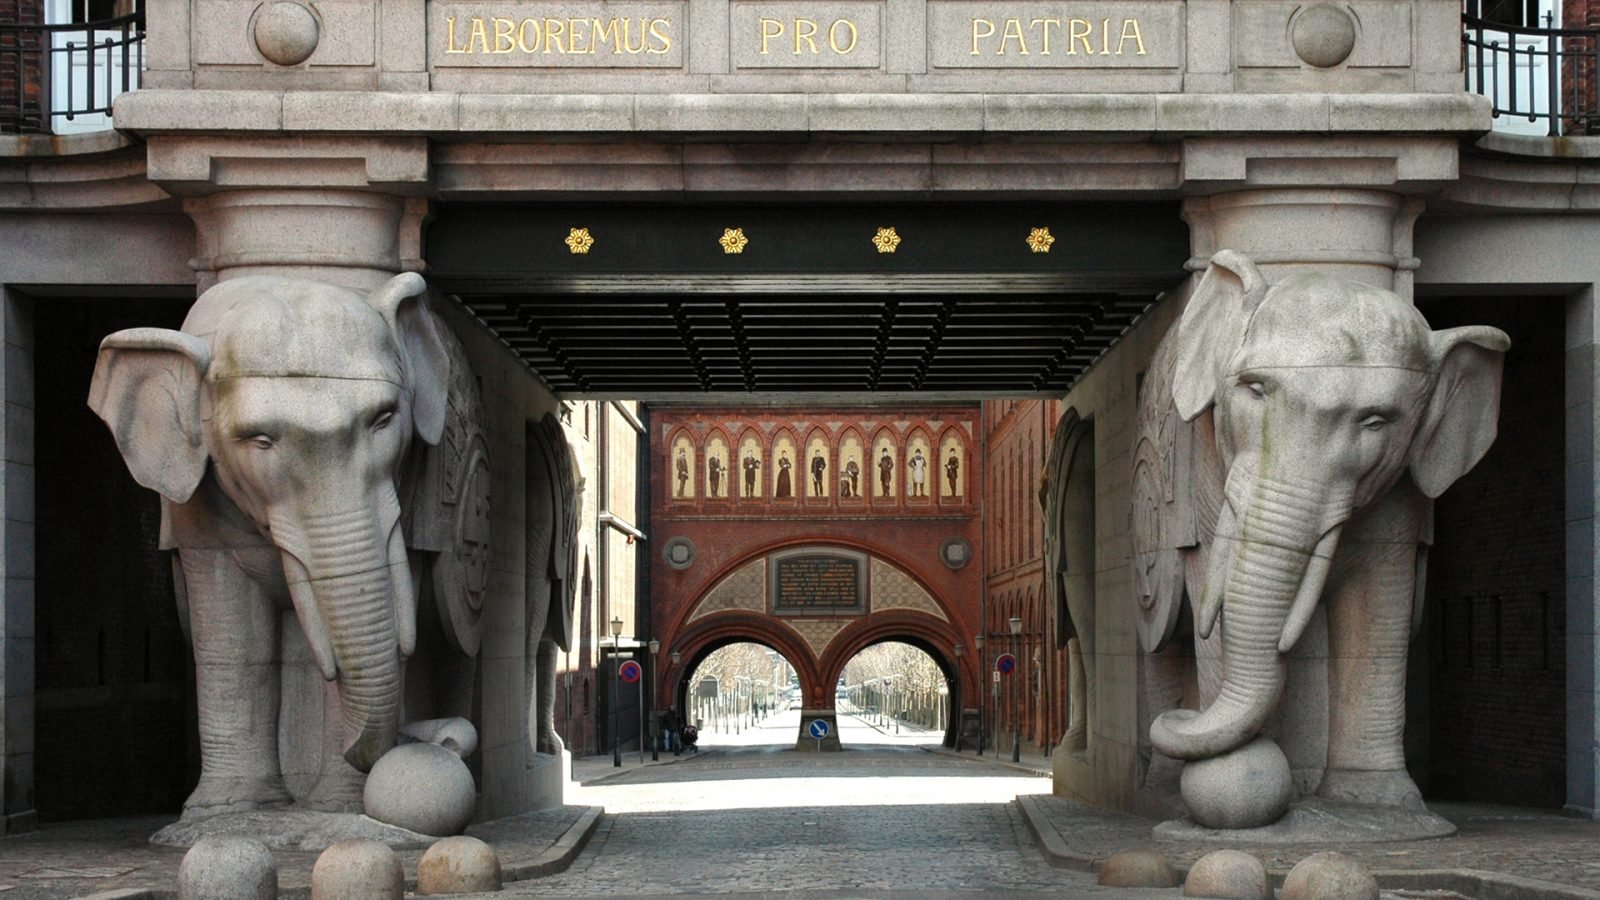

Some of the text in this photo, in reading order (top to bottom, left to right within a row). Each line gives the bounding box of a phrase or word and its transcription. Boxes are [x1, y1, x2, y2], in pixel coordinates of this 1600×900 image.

[446, 16, 1147, 56] LABOREMUS PRO PATRIA
